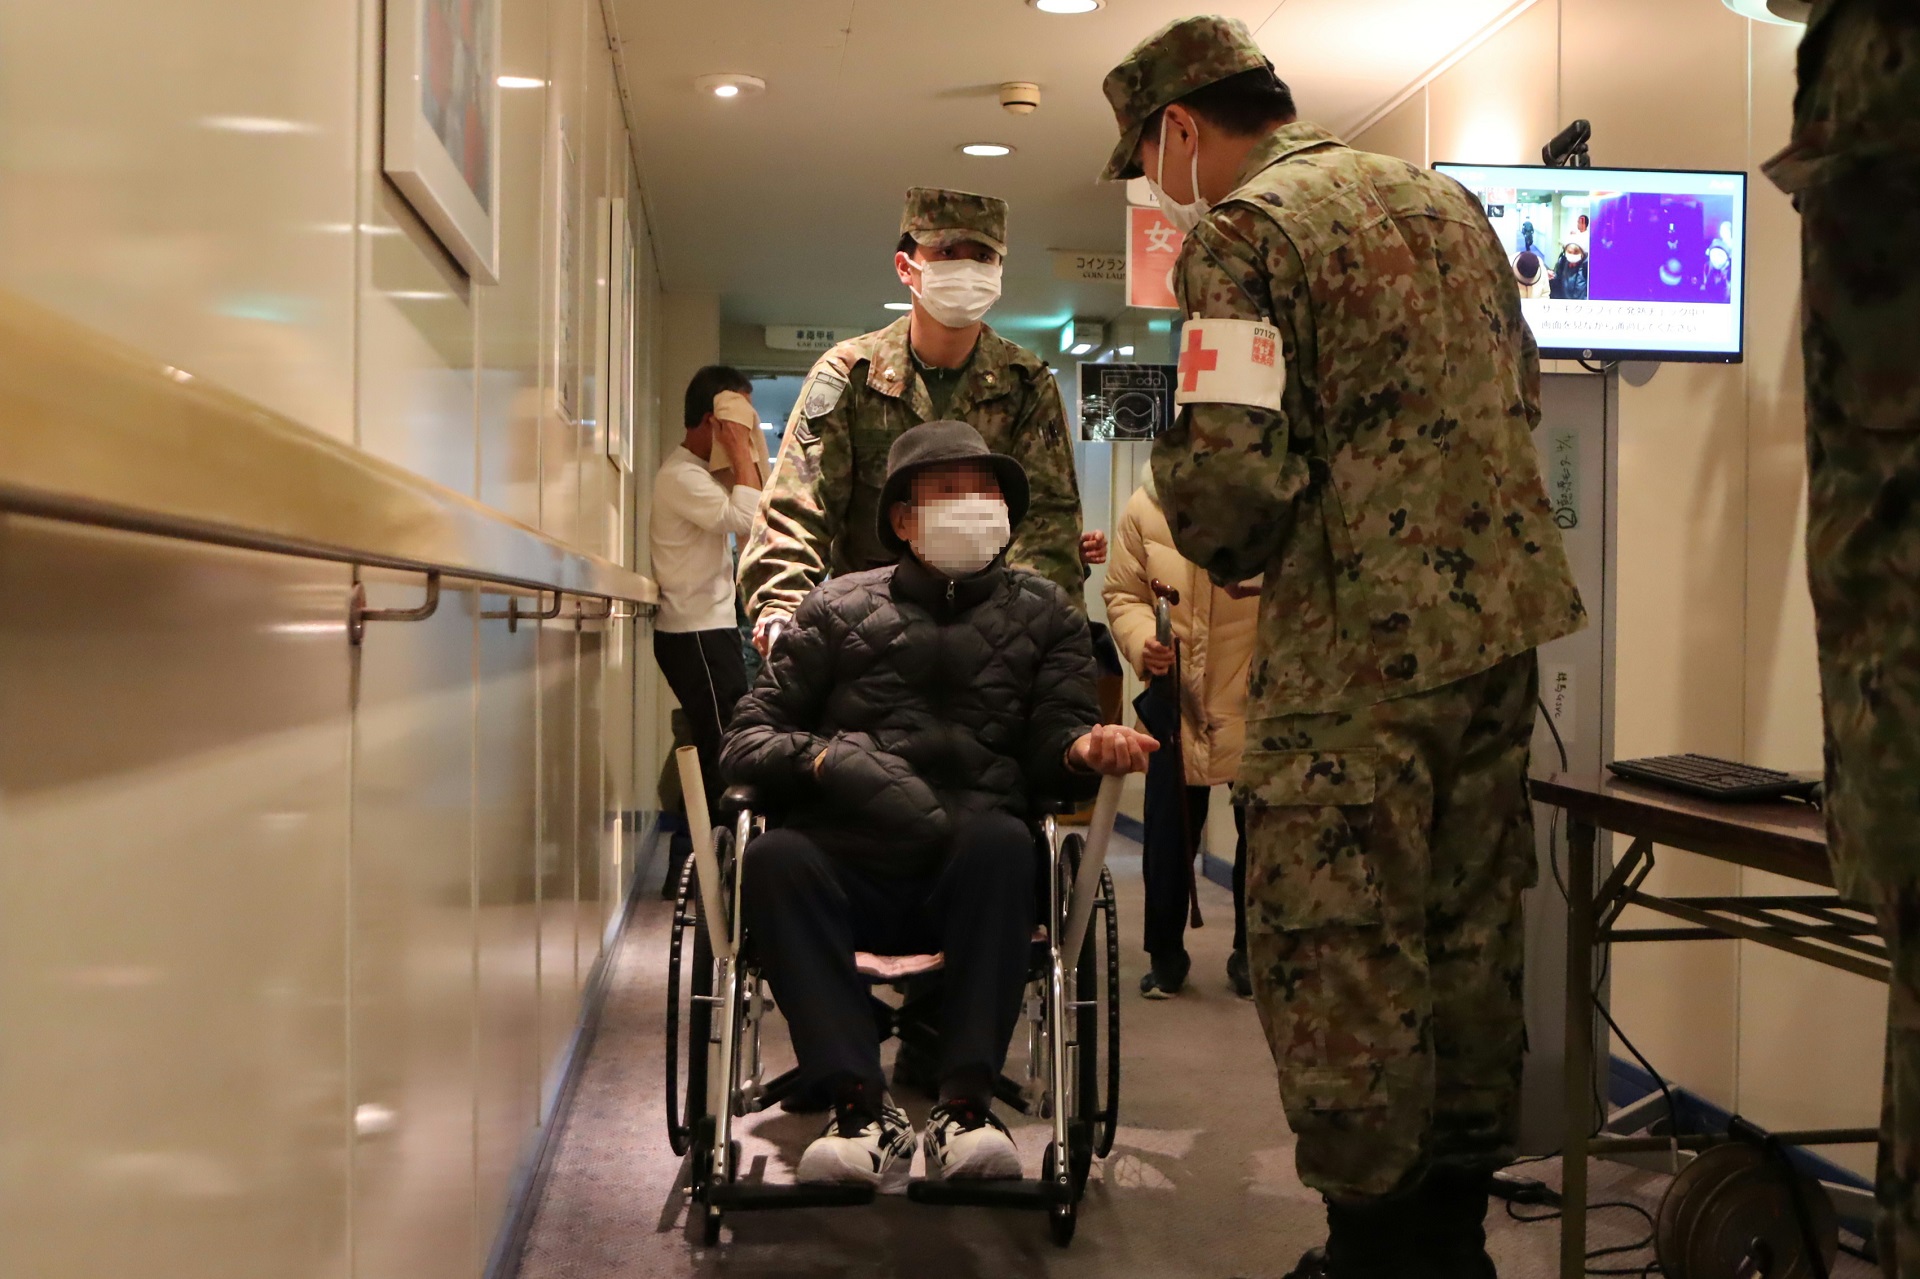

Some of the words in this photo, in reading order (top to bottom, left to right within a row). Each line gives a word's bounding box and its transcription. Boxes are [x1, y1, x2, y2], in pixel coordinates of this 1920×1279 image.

[1143, 220, 1177, 253] 女
[1082, 271, 1104, 279] COIN
[1254, 327, 1276, 340] D7127
